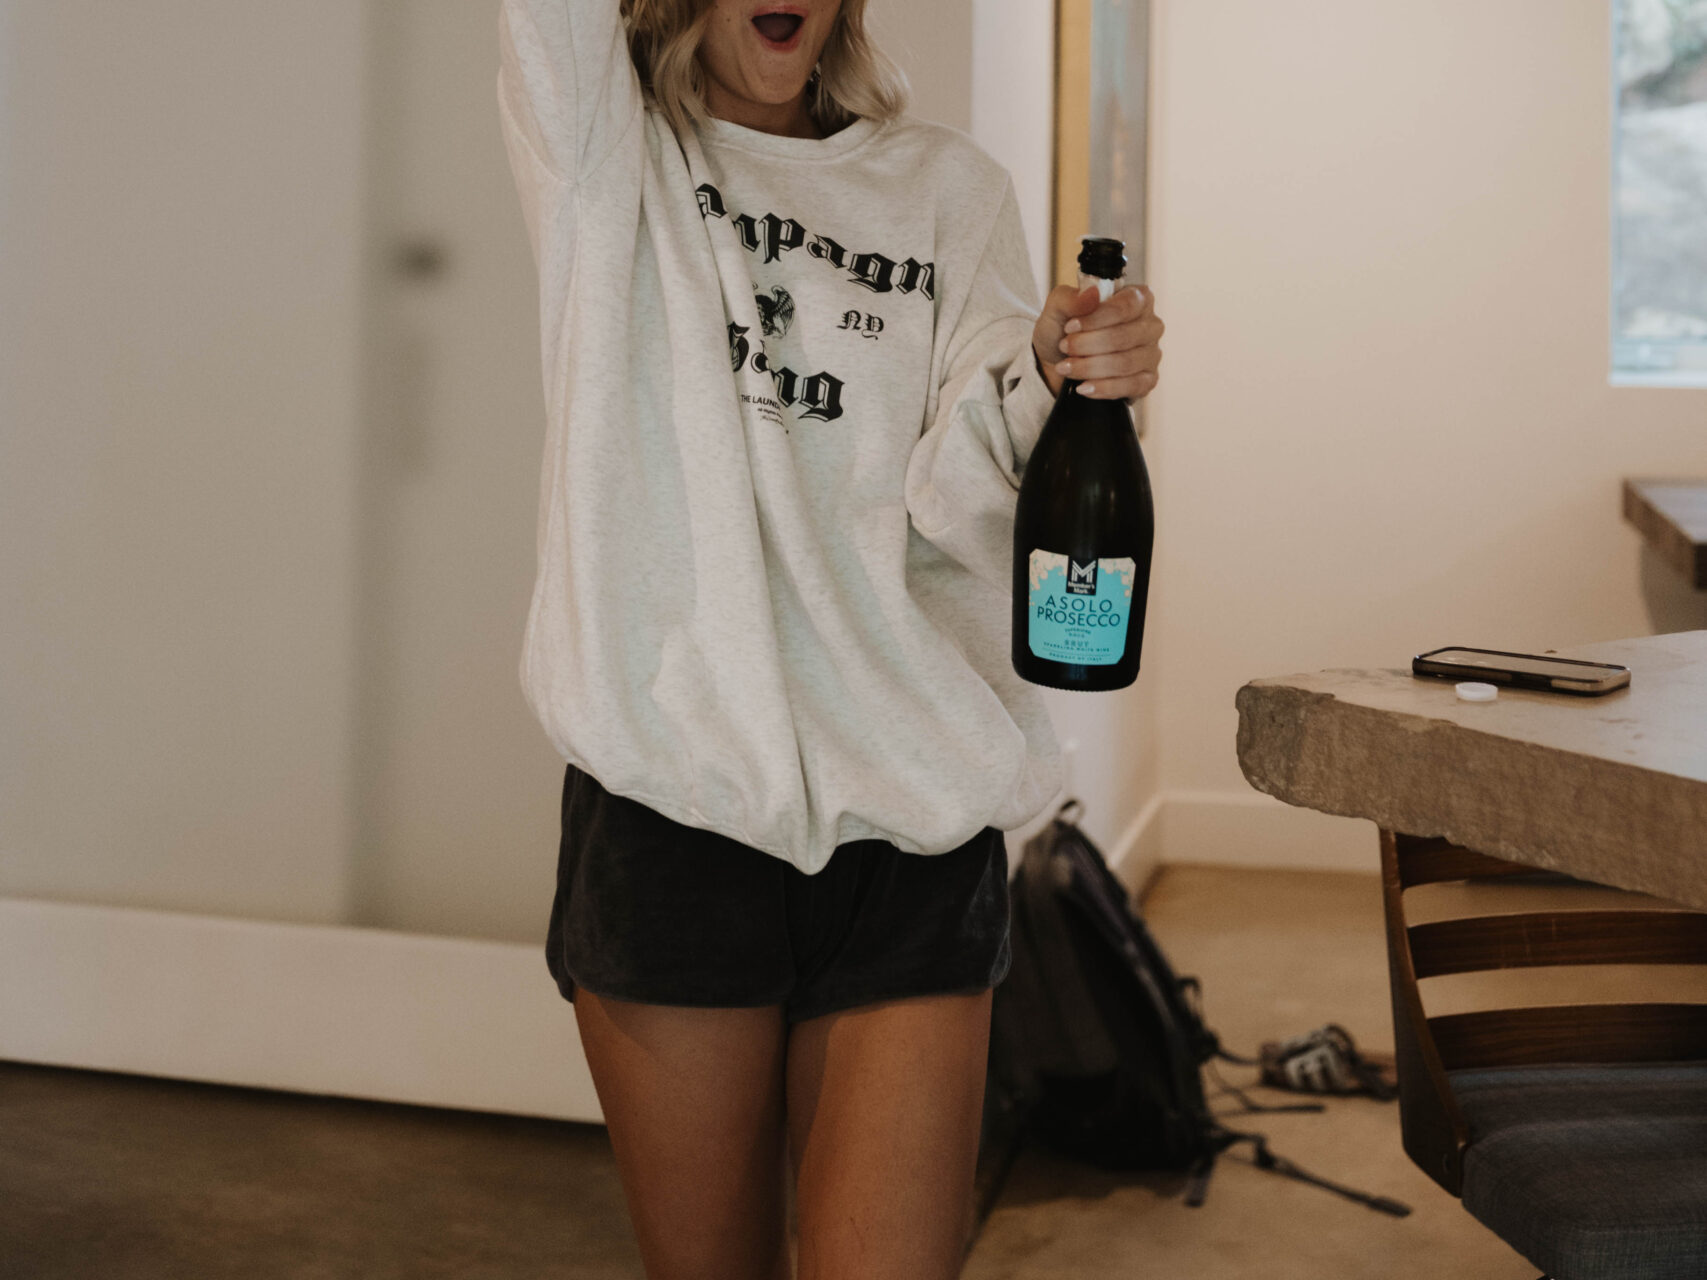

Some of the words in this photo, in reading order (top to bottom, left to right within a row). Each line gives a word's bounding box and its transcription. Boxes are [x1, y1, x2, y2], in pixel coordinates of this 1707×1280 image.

[741, 394, 751, 403] THE
[1045, 595, 1113, 613] ASOLO
[1037, 606, 1121, 628] PROSECCO
[1064, 639, 1090, 648] BRUT
